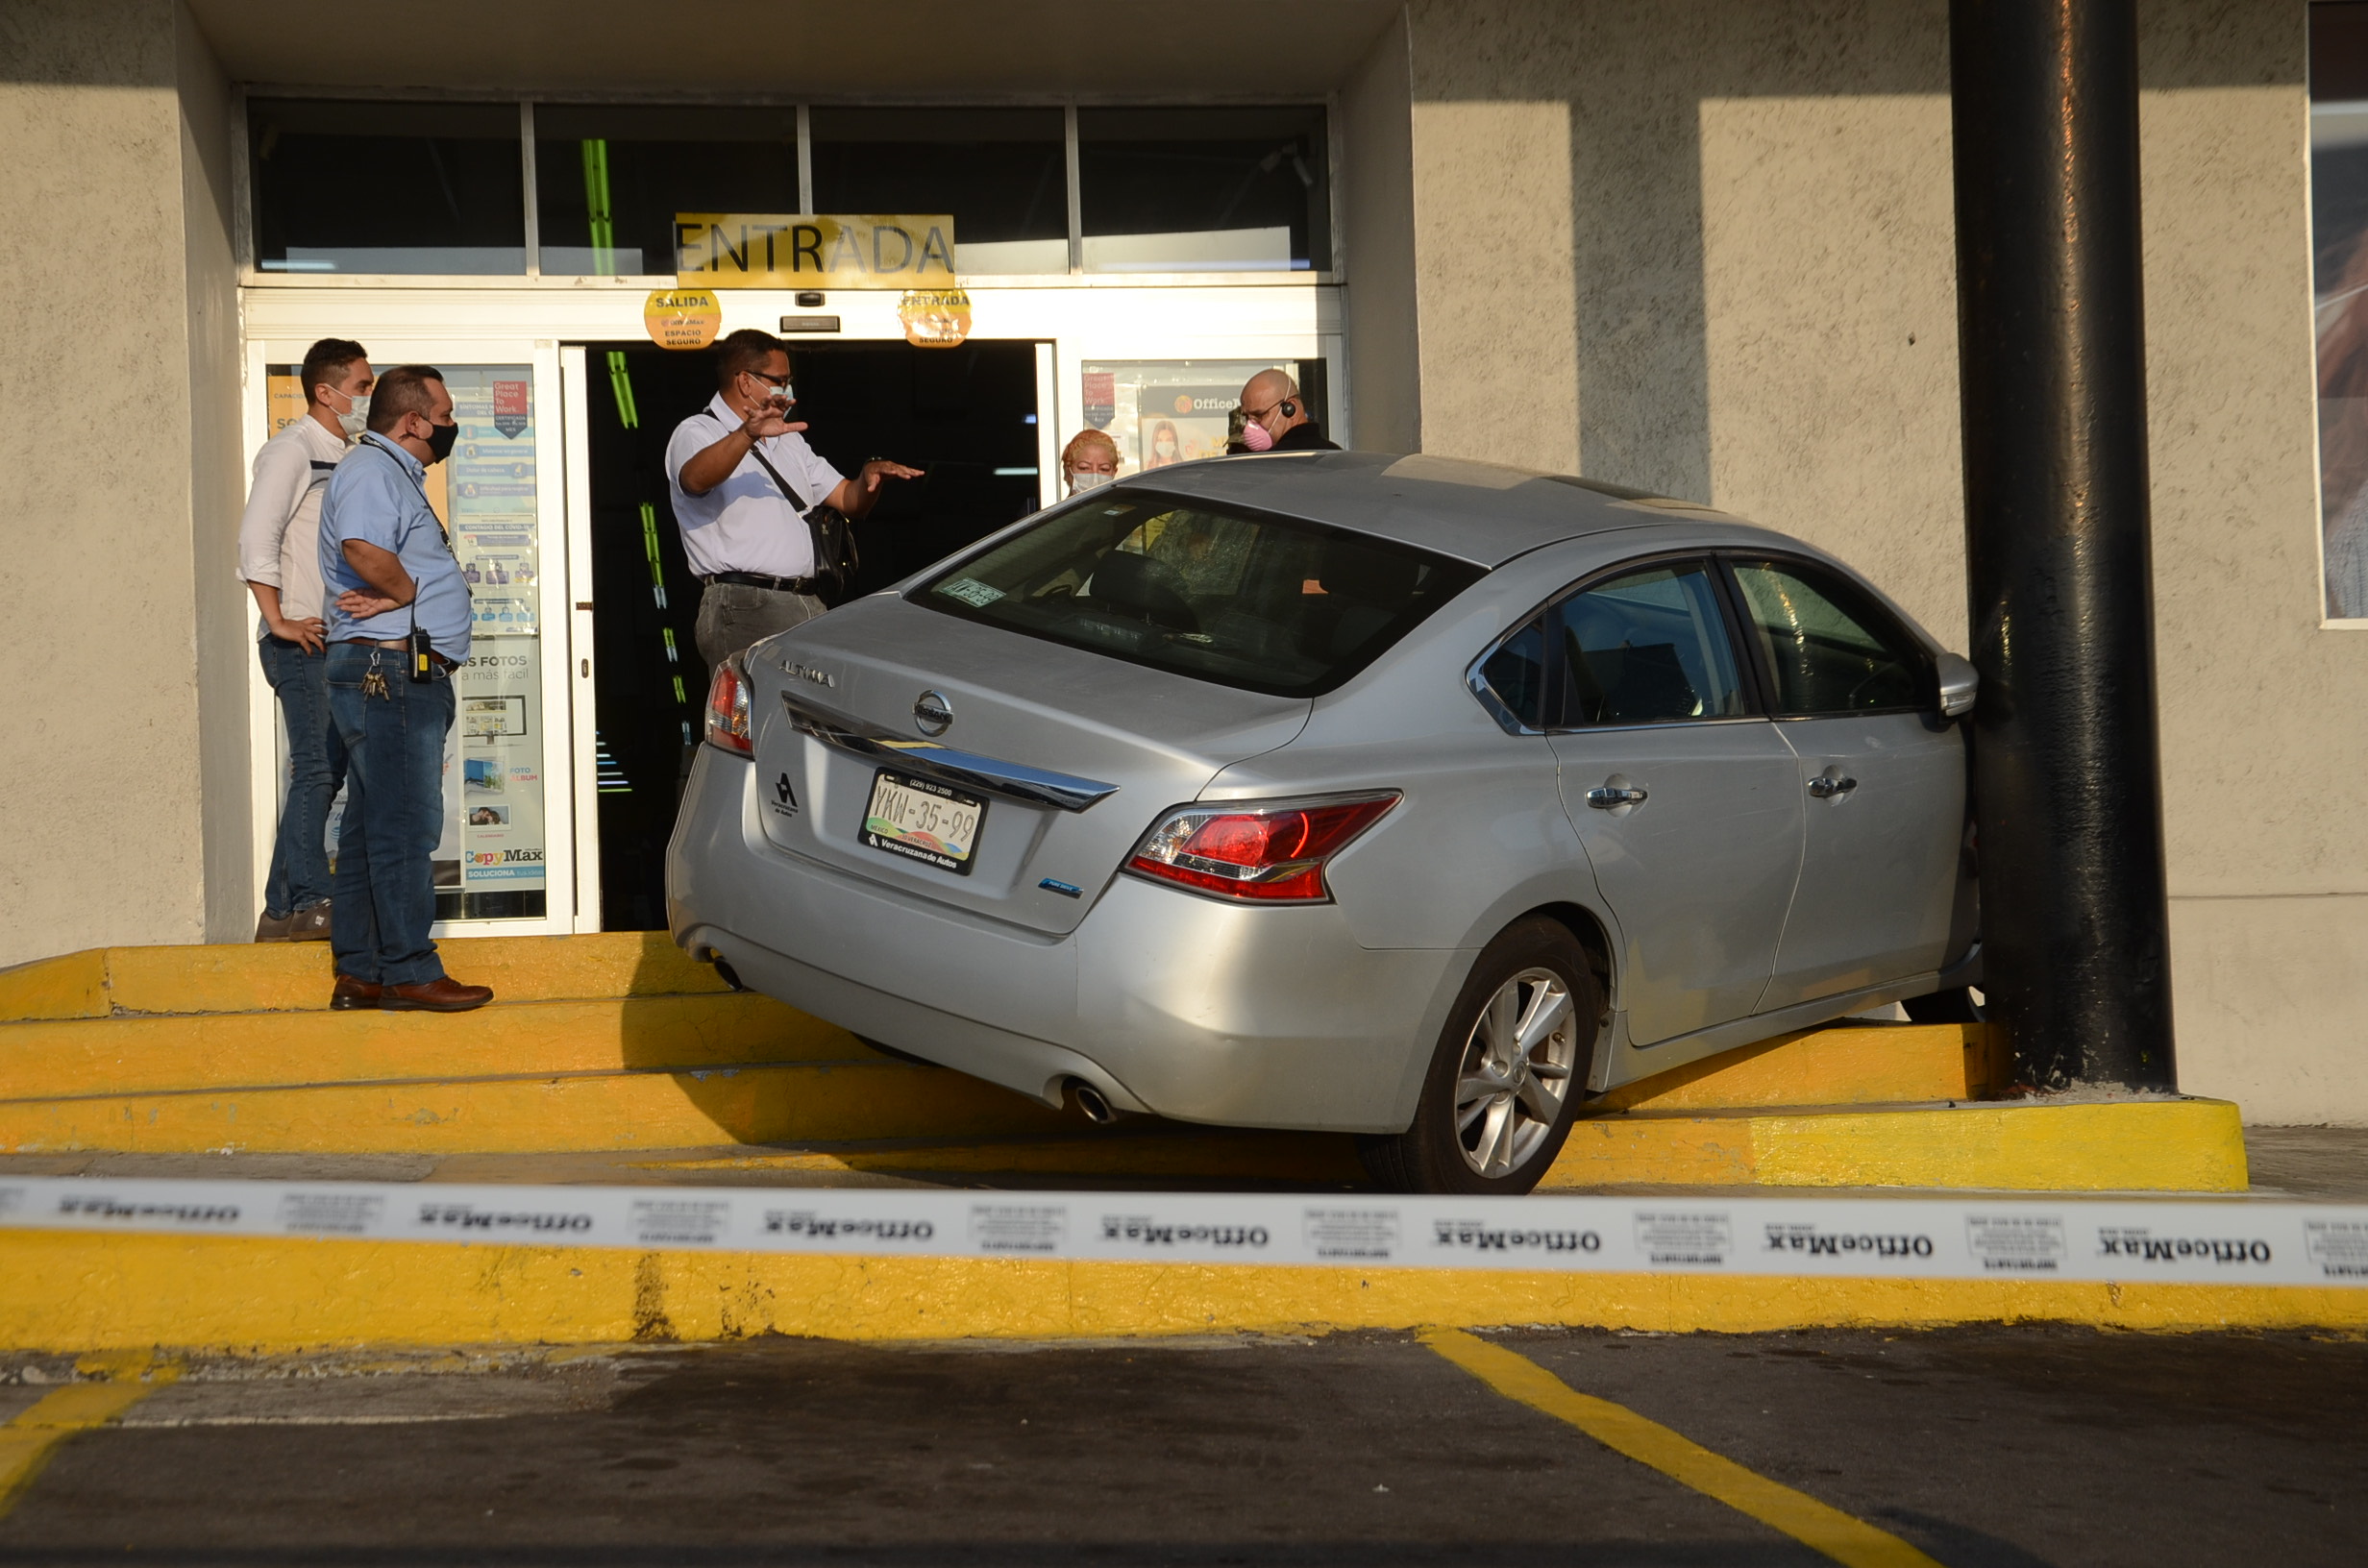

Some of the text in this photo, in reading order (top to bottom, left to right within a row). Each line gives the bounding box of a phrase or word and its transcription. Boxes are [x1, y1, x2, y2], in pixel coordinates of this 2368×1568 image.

[677, 223, 954, 274] ENTRADA
[655, 296, 708, 307] SALIDA
[902, 295, 970, 306] ENTRADA
[481, 655, 528, 667] FOTOS
[473, 669, 500, 680] más
[779, 660, 835, 688] ALTIMA
[915, 703, 950, 721] NISSAN
[909, 779, 952, 796] (229) 923 2500
[874, 785, 975, 843] YKW-35-99
[465, 849, 543, 866] CopyMax
[937, 855, 957, 869] Autos
[468, 869, 515, 878] SOLUCIONA
[766, 1217, 934, 1240] OfficeMax
[1102, 1225, 1269, 1246] OfficeMax
[1436, 1230, 1601, 1251] OfficeMax
[1765, 1234, 1934, 1259] OfficeMax
[2102, 1237, 2271, 1263] OfficeMax
